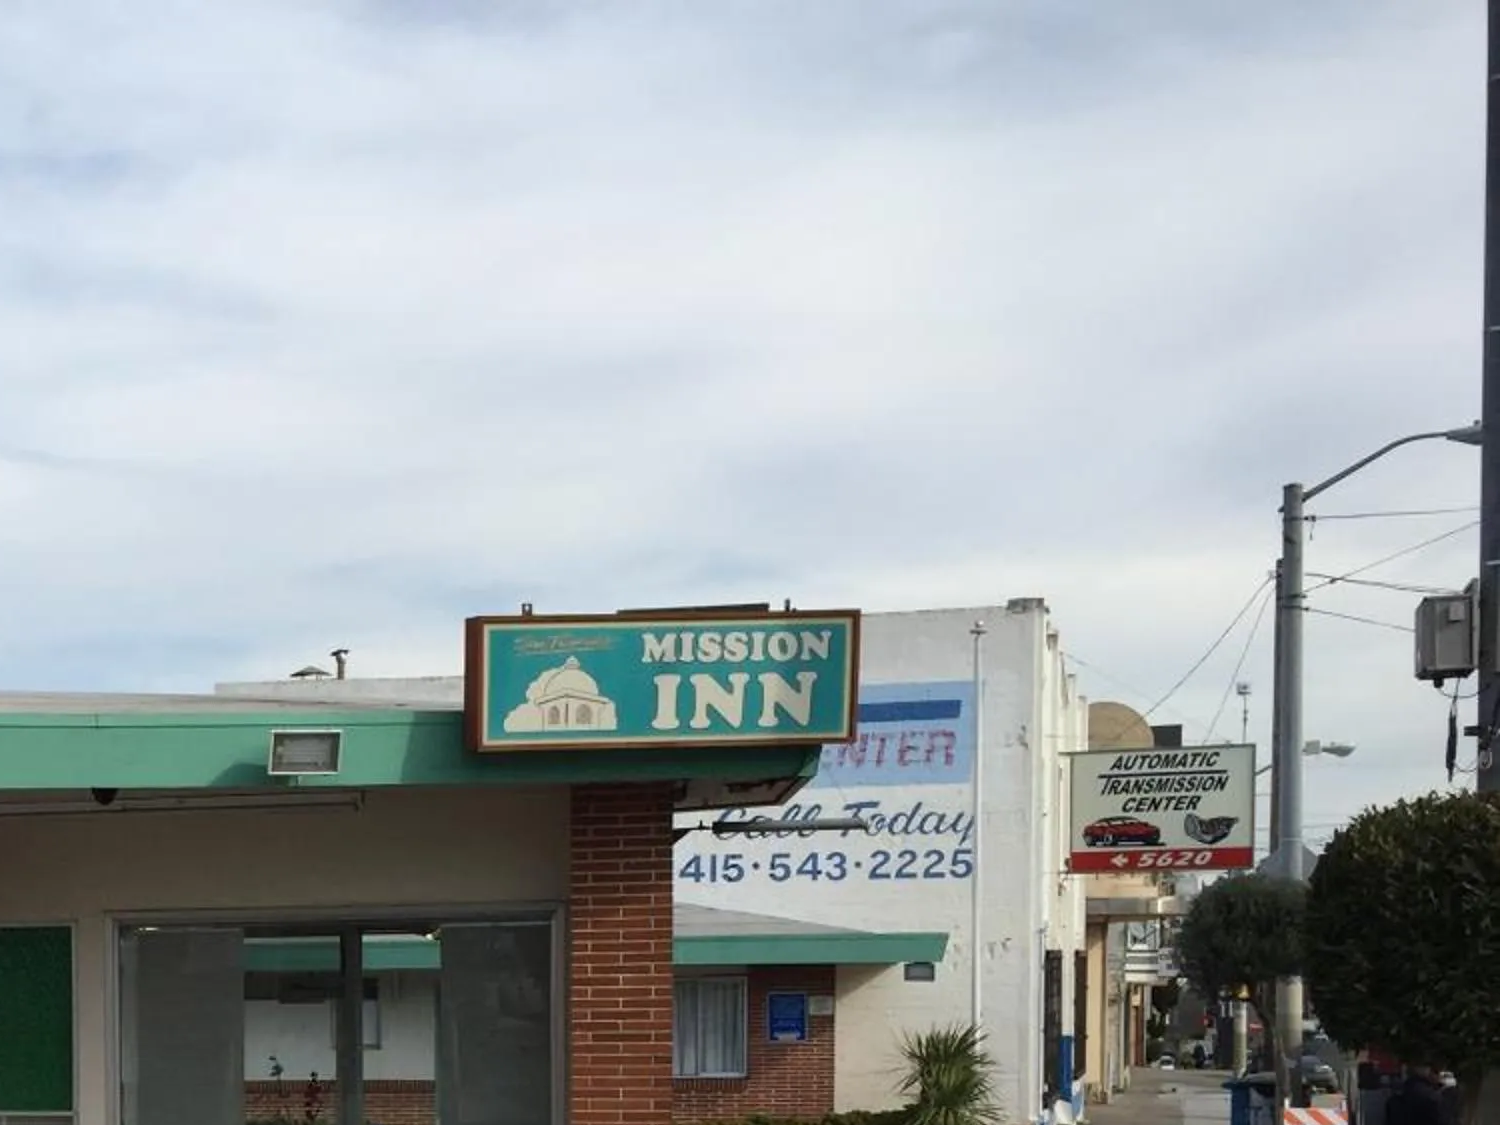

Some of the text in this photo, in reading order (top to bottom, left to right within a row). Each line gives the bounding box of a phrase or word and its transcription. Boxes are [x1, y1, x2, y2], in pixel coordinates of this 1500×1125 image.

[641, 630, 833, 663] MISSION
[651, 671, 818, 729] INN
[822, 729, 957, 768] NTER
[1110, 752, 1220, 770] AUTOMATIC
[1098, 774, 1229, 795] TRANSMISSION
[1122, 796, 1201, 813] CENTER
[841, 800, 975, 846] Today
[1137, 852, 1213, 867] 5620
